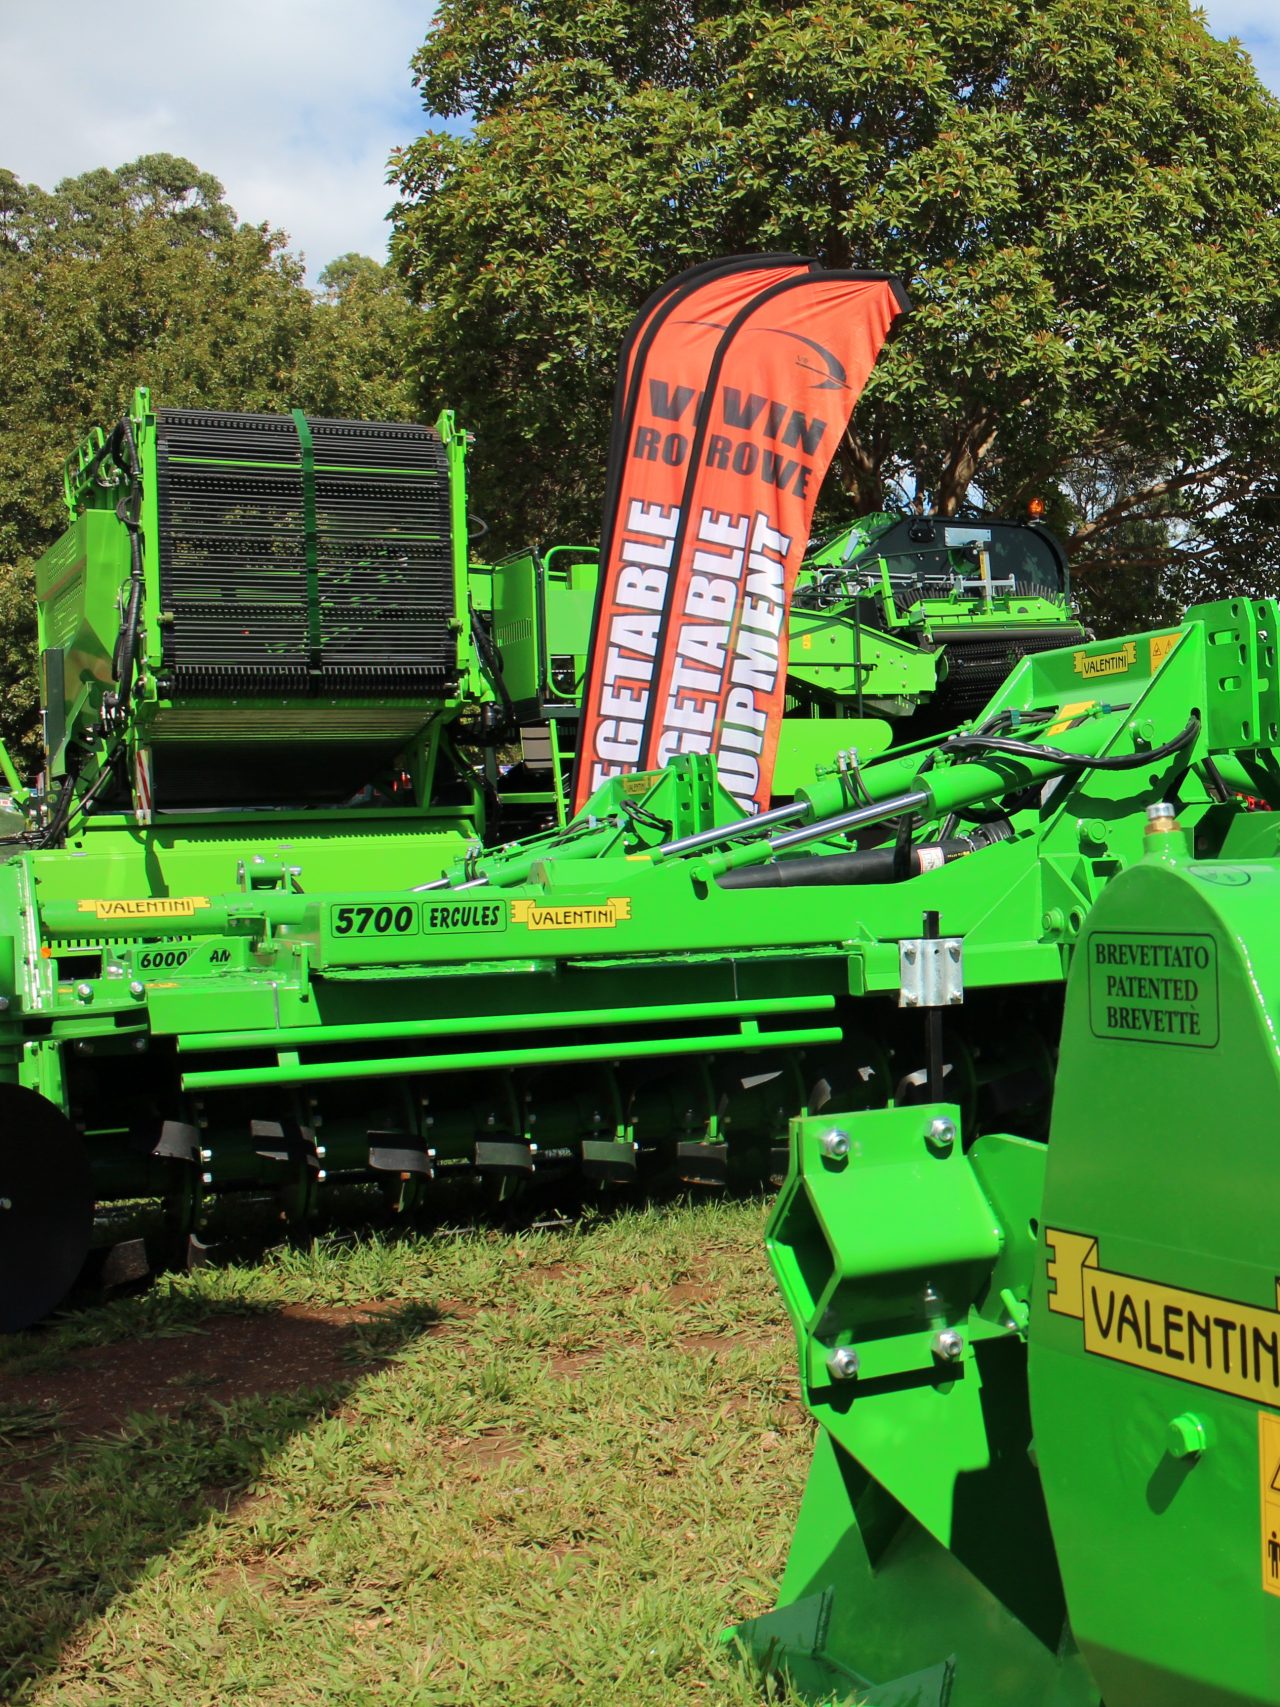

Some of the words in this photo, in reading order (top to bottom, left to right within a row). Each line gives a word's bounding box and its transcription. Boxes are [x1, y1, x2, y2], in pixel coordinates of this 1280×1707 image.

[723, 386, 827, 457] VIN
[633, 425, 689, 467] RO
[706, 434, 813, 500] ROWE
[590, 498, 681, 795] EGETABLE
[656, 507, 750, 769] GETABLE
[717, 510, 792, 814] UIPMENT
[1084, 655, 1127, 674] VALENTINI
[100, 900, 191, 914] VALENTINI
[335, 906, 414, 935] 5700
[429, 905, 500, 929] ERCULES
[531, 909, 613, 925] VALENTINI
[140, 951, 188, 968] 6000
[1095, 943, 1209, 969] BREVETTATO
[1106, 975, 1199, 1002] PATENTED
[1106, 1004, 1201, 1036] BREVETTÈ
